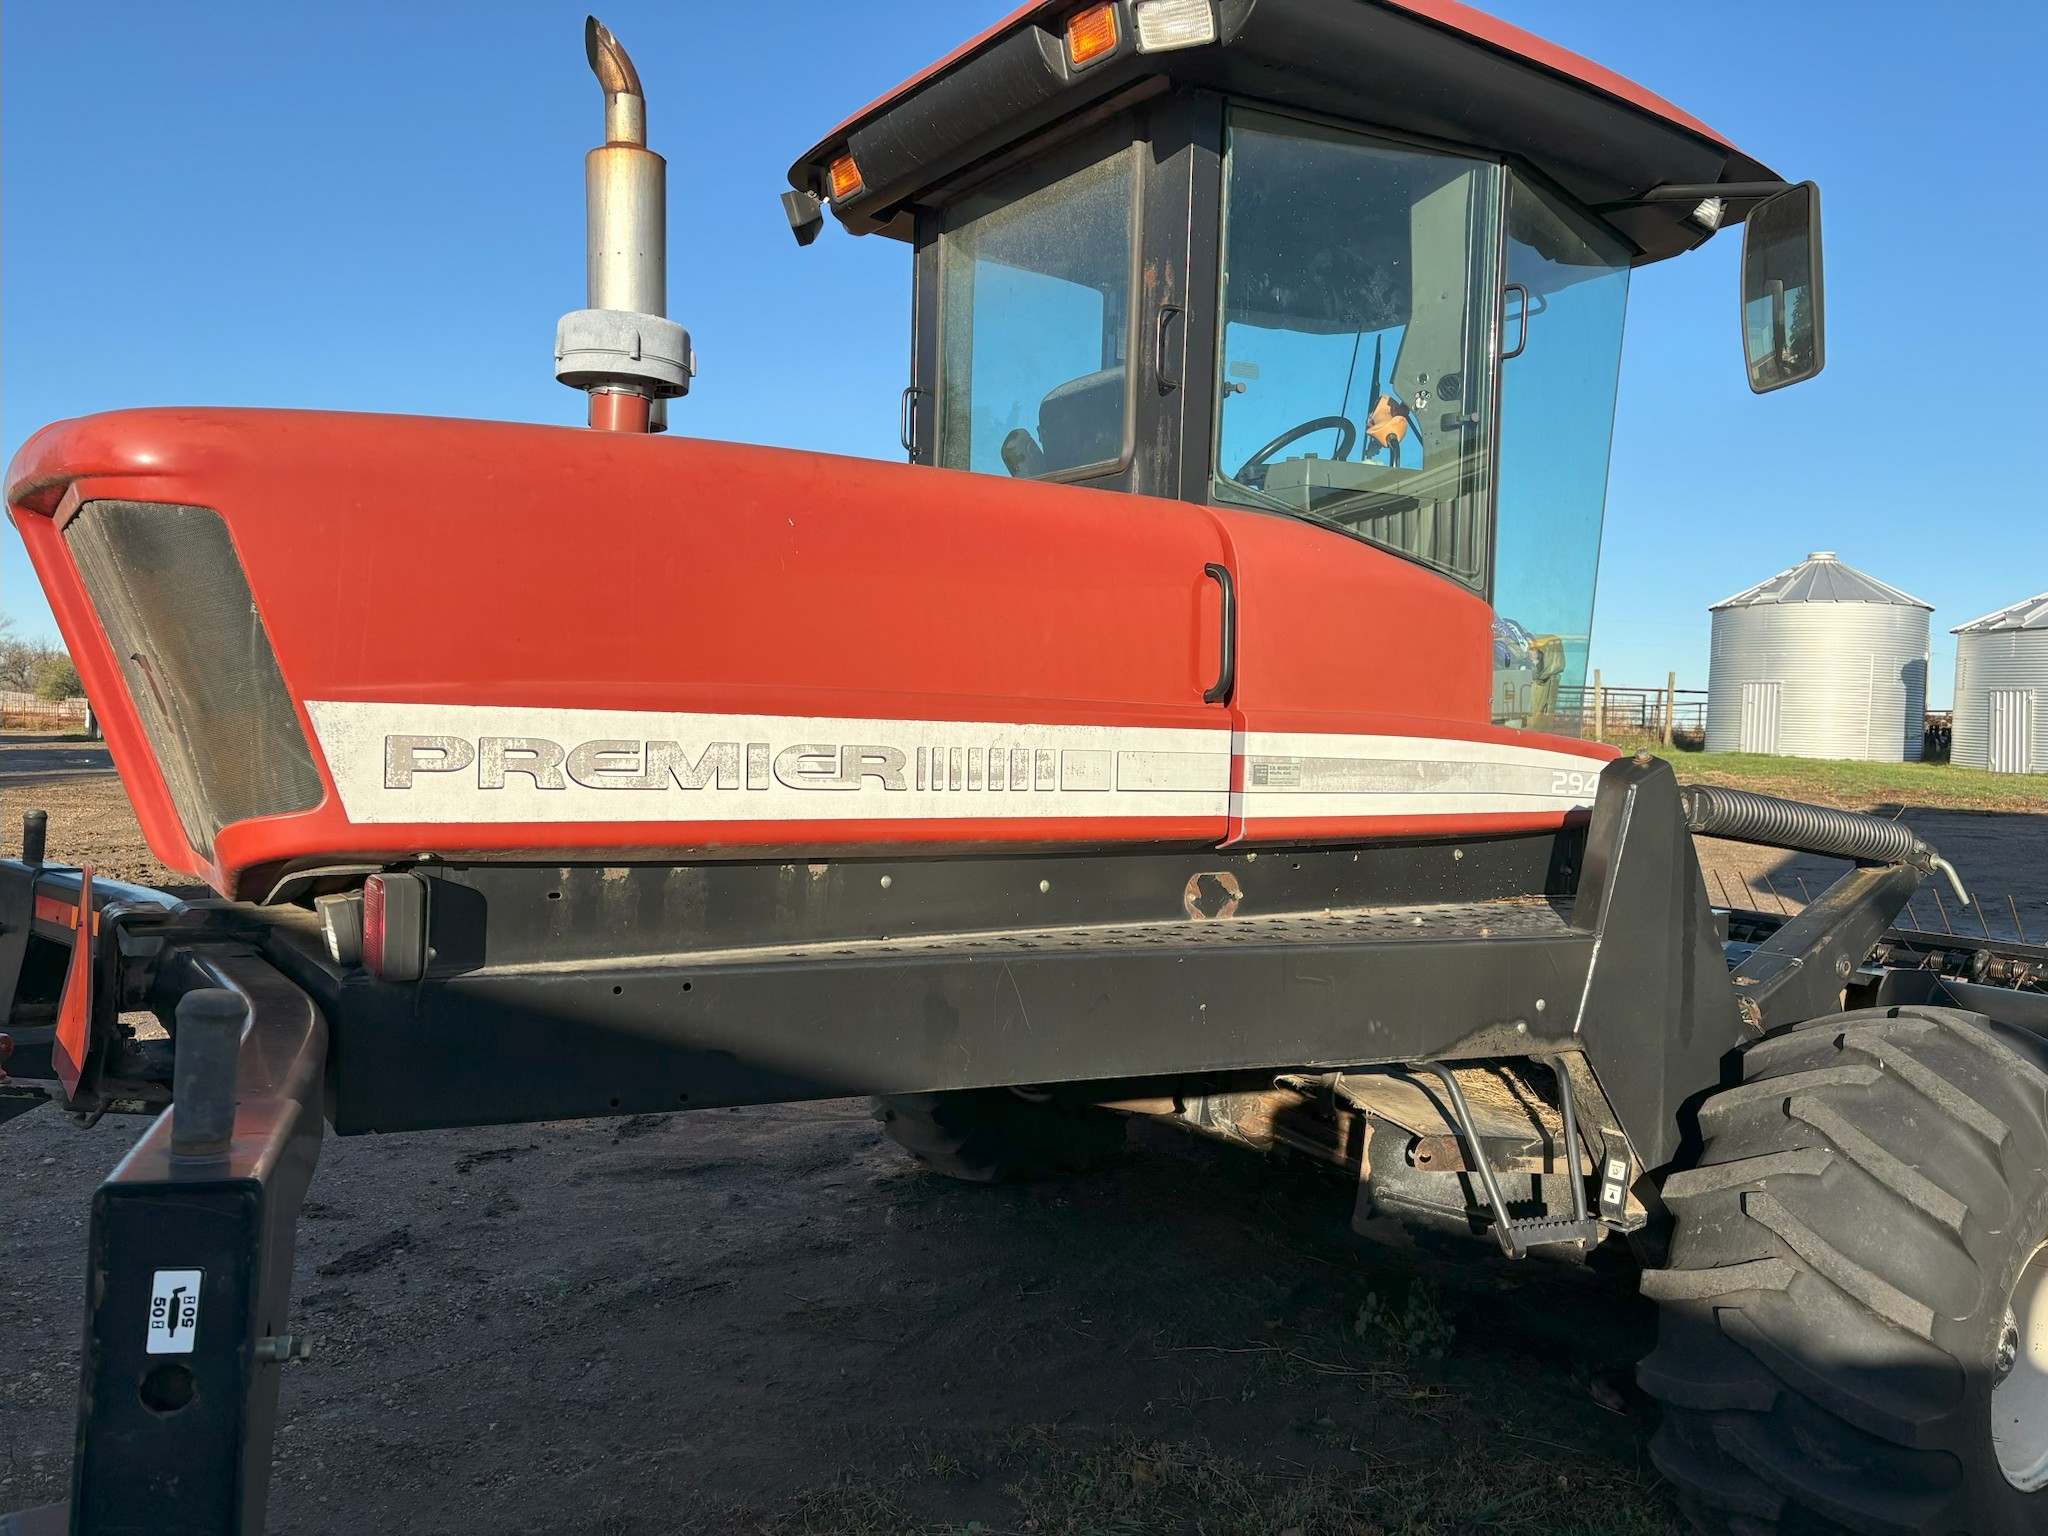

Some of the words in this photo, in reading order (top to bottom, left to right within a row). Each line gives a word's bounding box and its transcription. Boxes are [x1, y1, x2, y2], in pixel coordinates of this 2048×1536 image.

[384, 735, 907, 791] PREMIER
[153, 1297, 166, 1317] 50
[182, 1307, 195, 1328] 50
